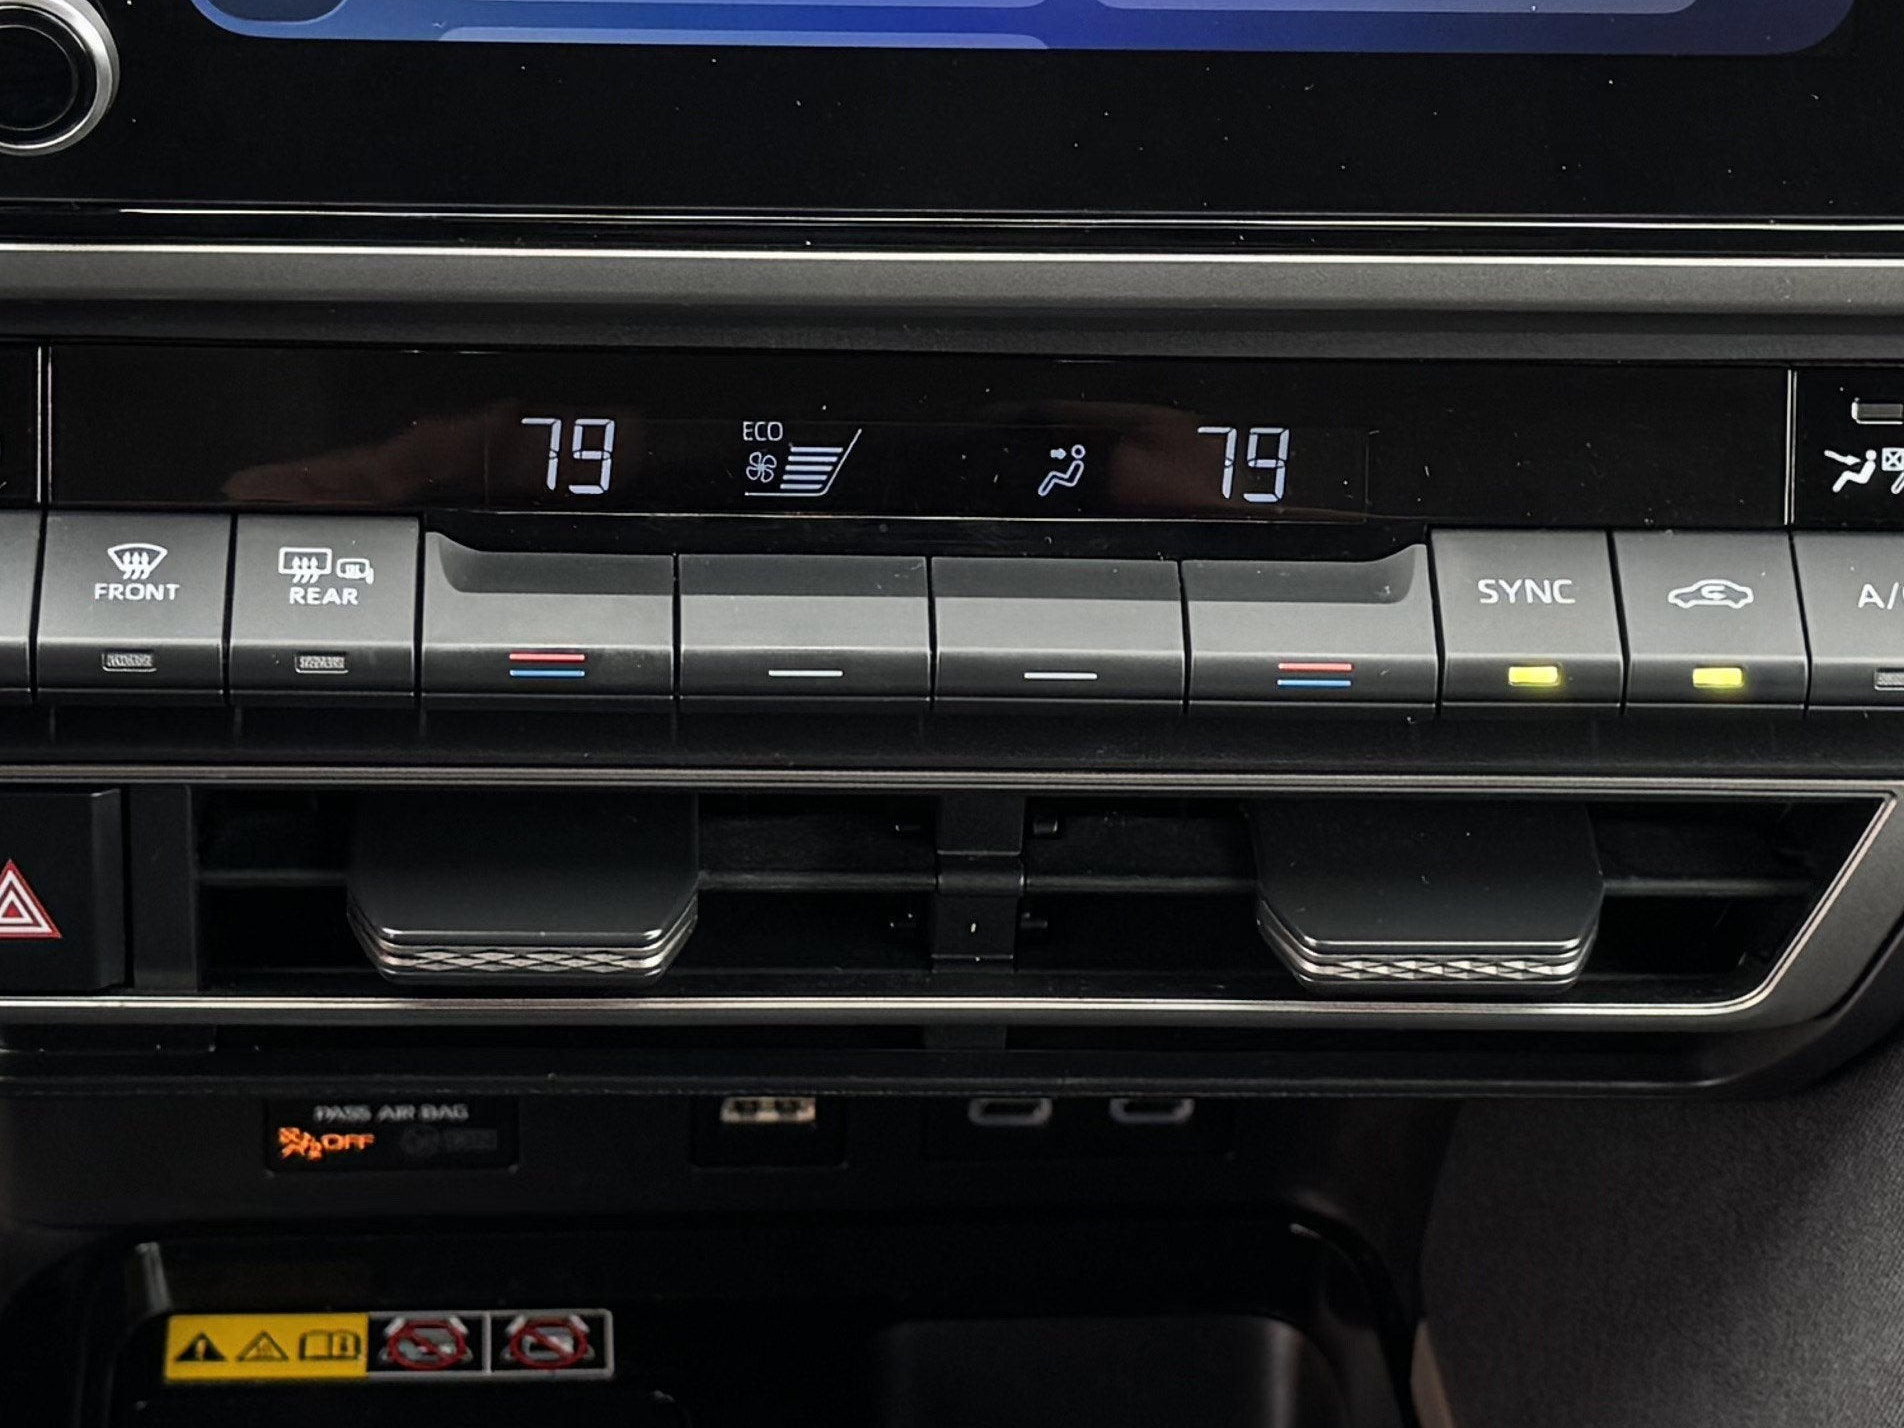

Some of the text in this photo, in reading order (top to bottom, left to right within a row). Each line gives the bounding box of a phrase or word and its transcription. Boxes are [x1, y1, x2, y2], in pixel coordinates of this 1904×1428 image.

[742, 421, 784, 442] ECO
[521, 417, 615, 495] 79
[1197, 426, 1290, 503] 79
[94, 582, 180, 601] FRONT
[289, 586, 359, 606] REAR
[1477, 579, 1576, 604] SYNC
[378, 1105, 415, 1121] AIR
[322, 1134, 374, 1151] OFF
